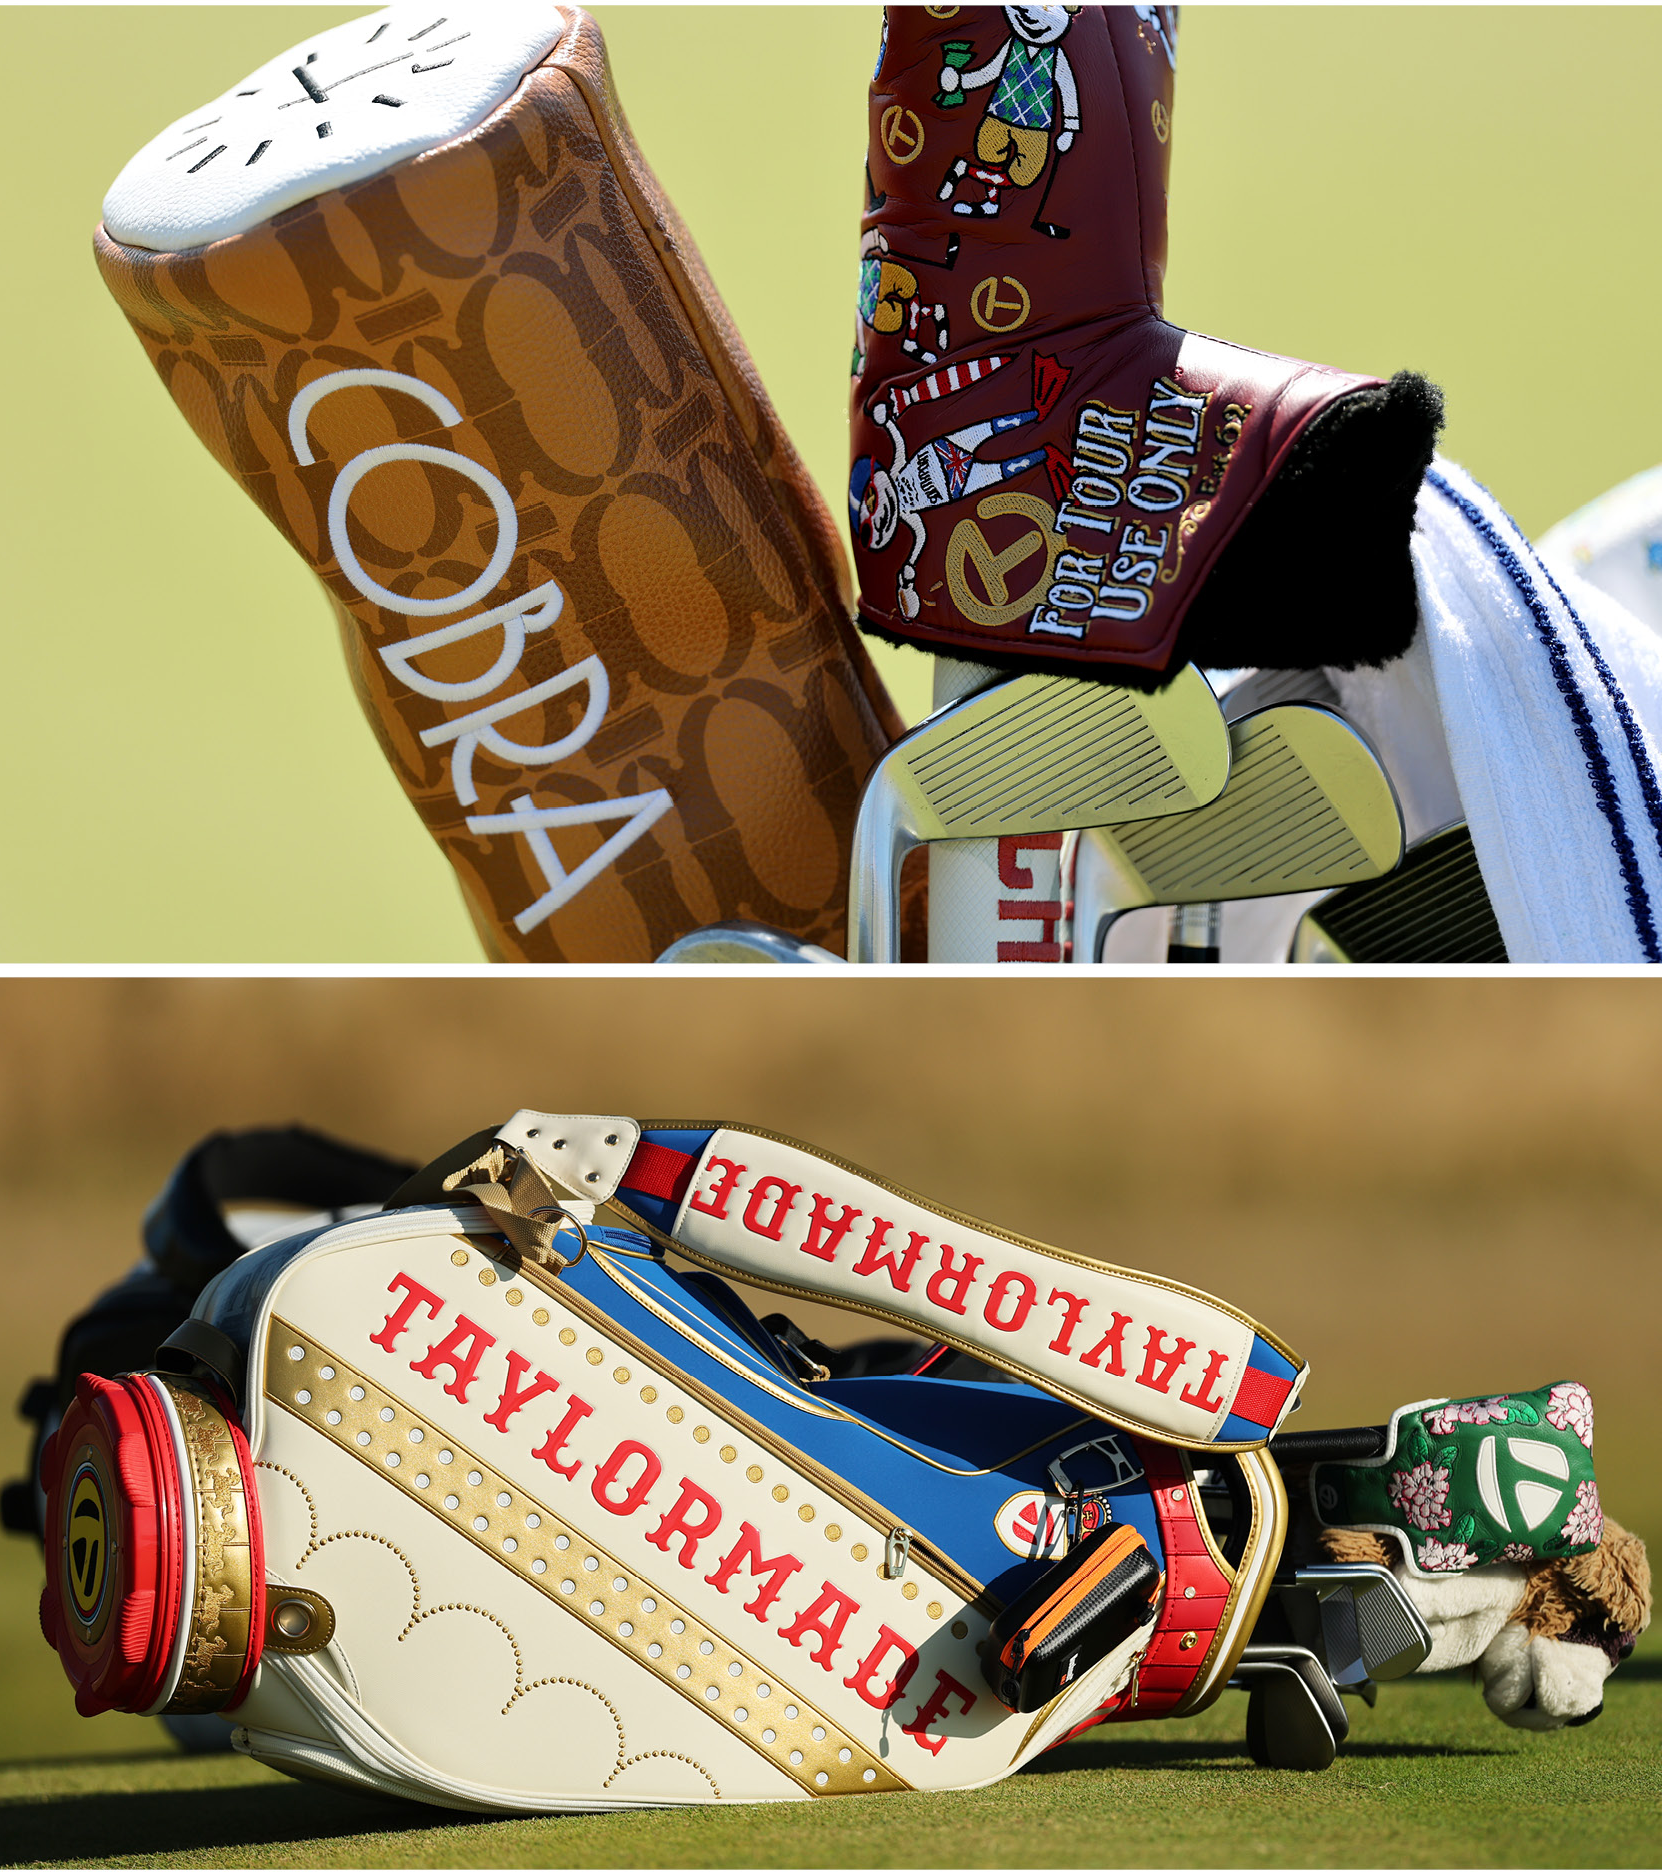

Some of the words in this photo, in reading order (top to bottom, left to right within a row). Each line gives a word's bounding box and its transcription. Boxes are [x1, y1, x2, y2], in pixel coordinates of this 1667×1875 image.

[917, 450, 944, 504] SOUTHPORT
[1052, 399, 1140, 537] TOUR
[1126, 377, 1213, 514] ONLY
[1027, 549, 1108, 640] FOR
[1089, 521, 1172, 622] USE
[287, 368, 675, 936] COBRA
[689, 1153, 1232, 1415] TAYLORMADE
[368, 1270, 980, 1758] TAYLORMADE
